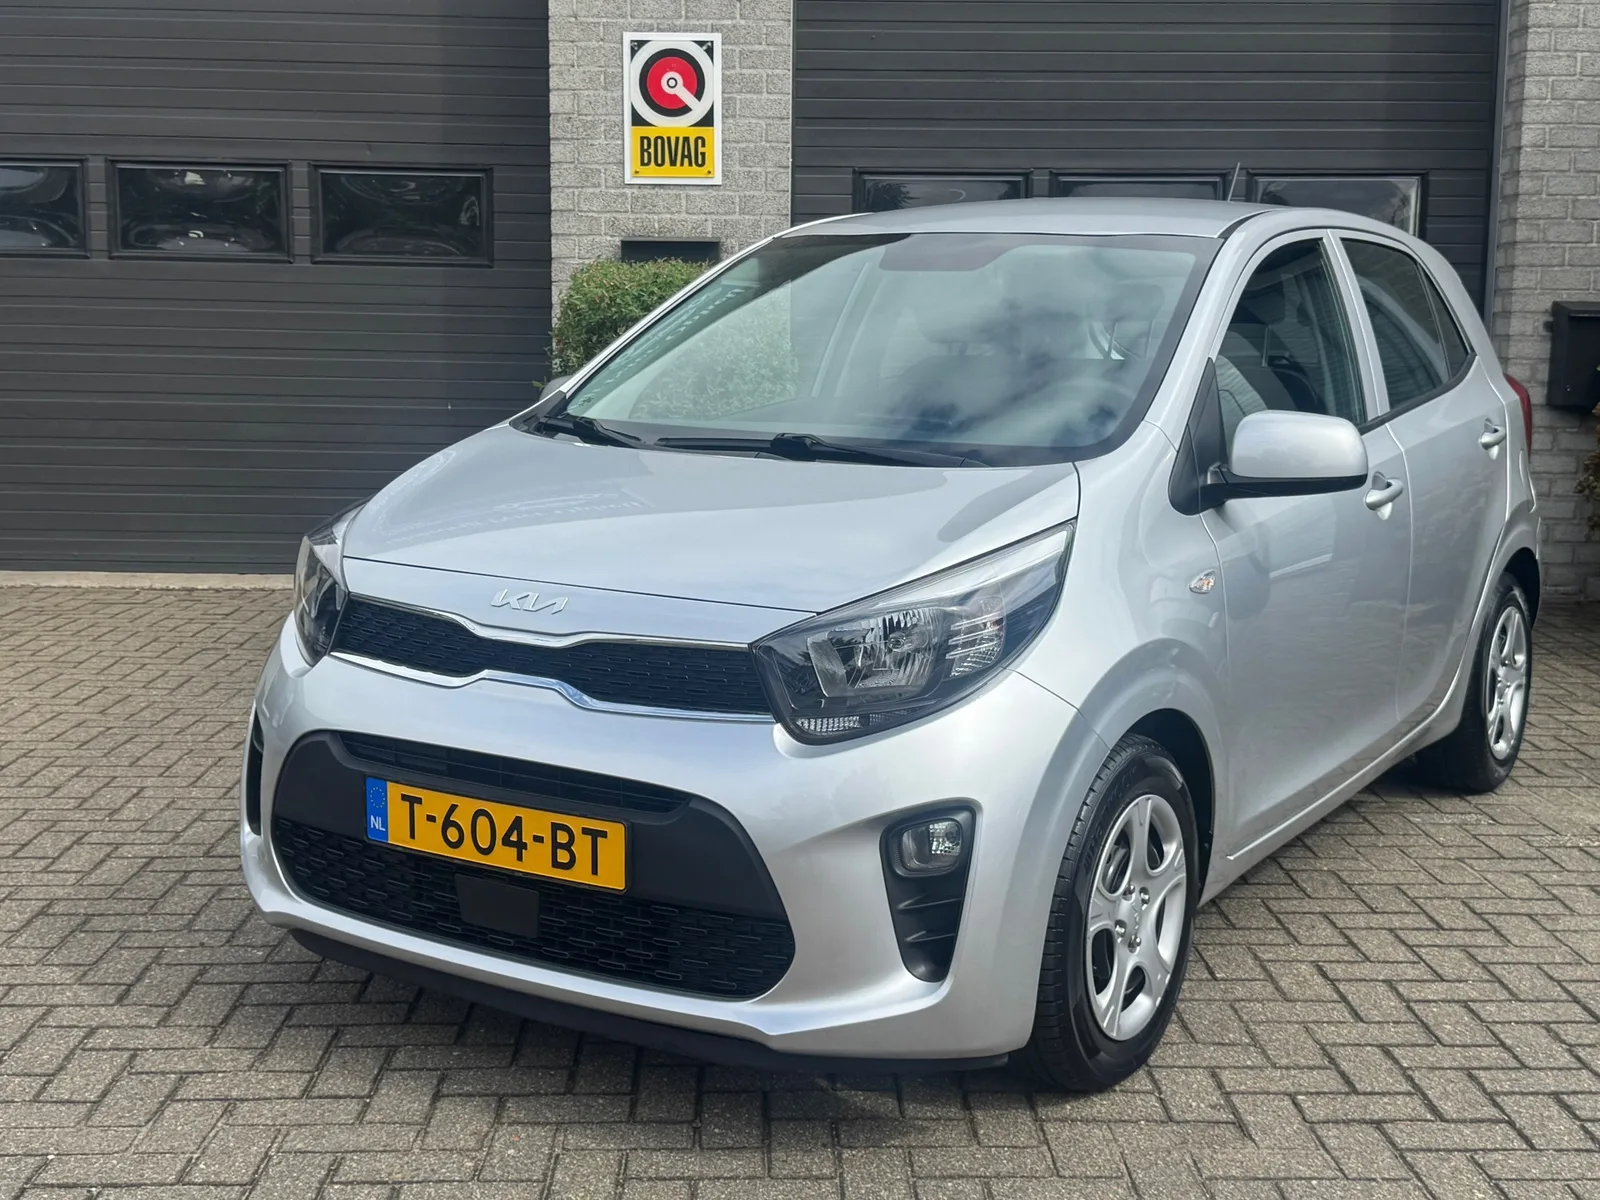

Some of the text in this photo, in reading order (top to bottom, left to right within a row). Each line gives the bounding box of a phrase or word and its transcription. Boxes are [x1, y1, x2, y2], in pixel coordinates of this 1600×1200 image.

[639, 135, 706, 168] BOVAG
[490, 588, 569, 615] KIA
[370, 814, 386, 832] NL
[400, 793, 608, 876] T-604-BT
